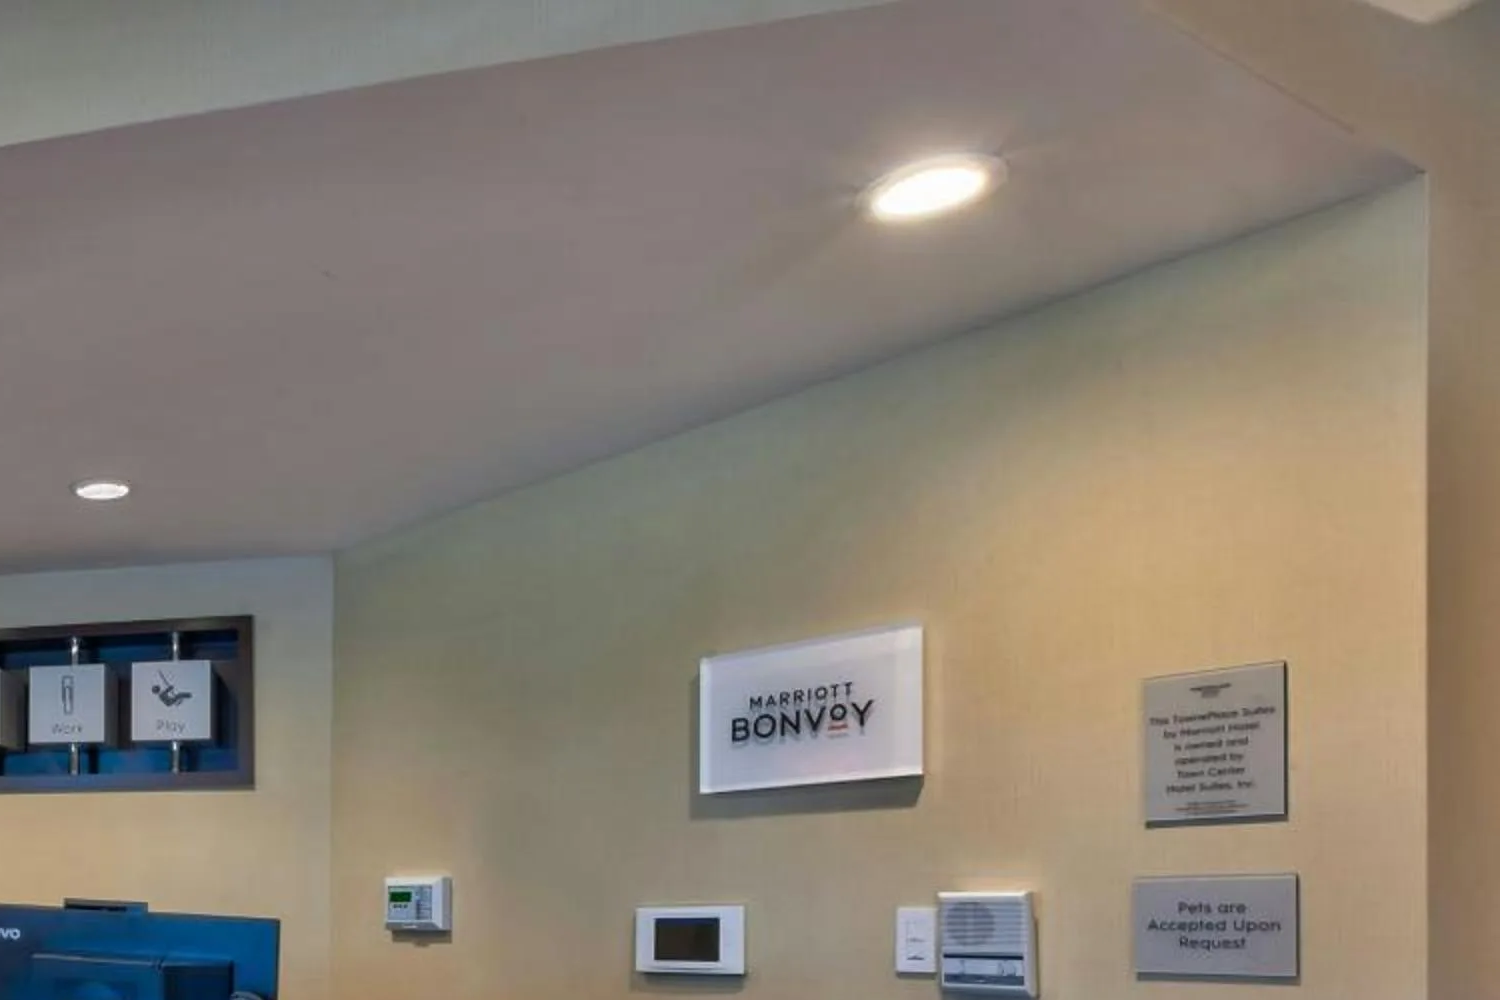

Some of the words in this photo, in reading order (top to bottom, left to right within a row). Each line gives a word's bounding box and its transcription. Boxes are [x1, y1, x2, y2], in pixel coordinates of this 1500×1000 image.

[749, 681, 853, 709] MARRIOTT
[156, 719, 186, 733] Play
[1177, 901, 1211, 914] Pets
[1217, 902, 1247, 914] are
[1147, 918, 1227, 933] Accepted
[1233, 919, 1282, 933] Upon
[1179, 935, 1246, 951] Request
